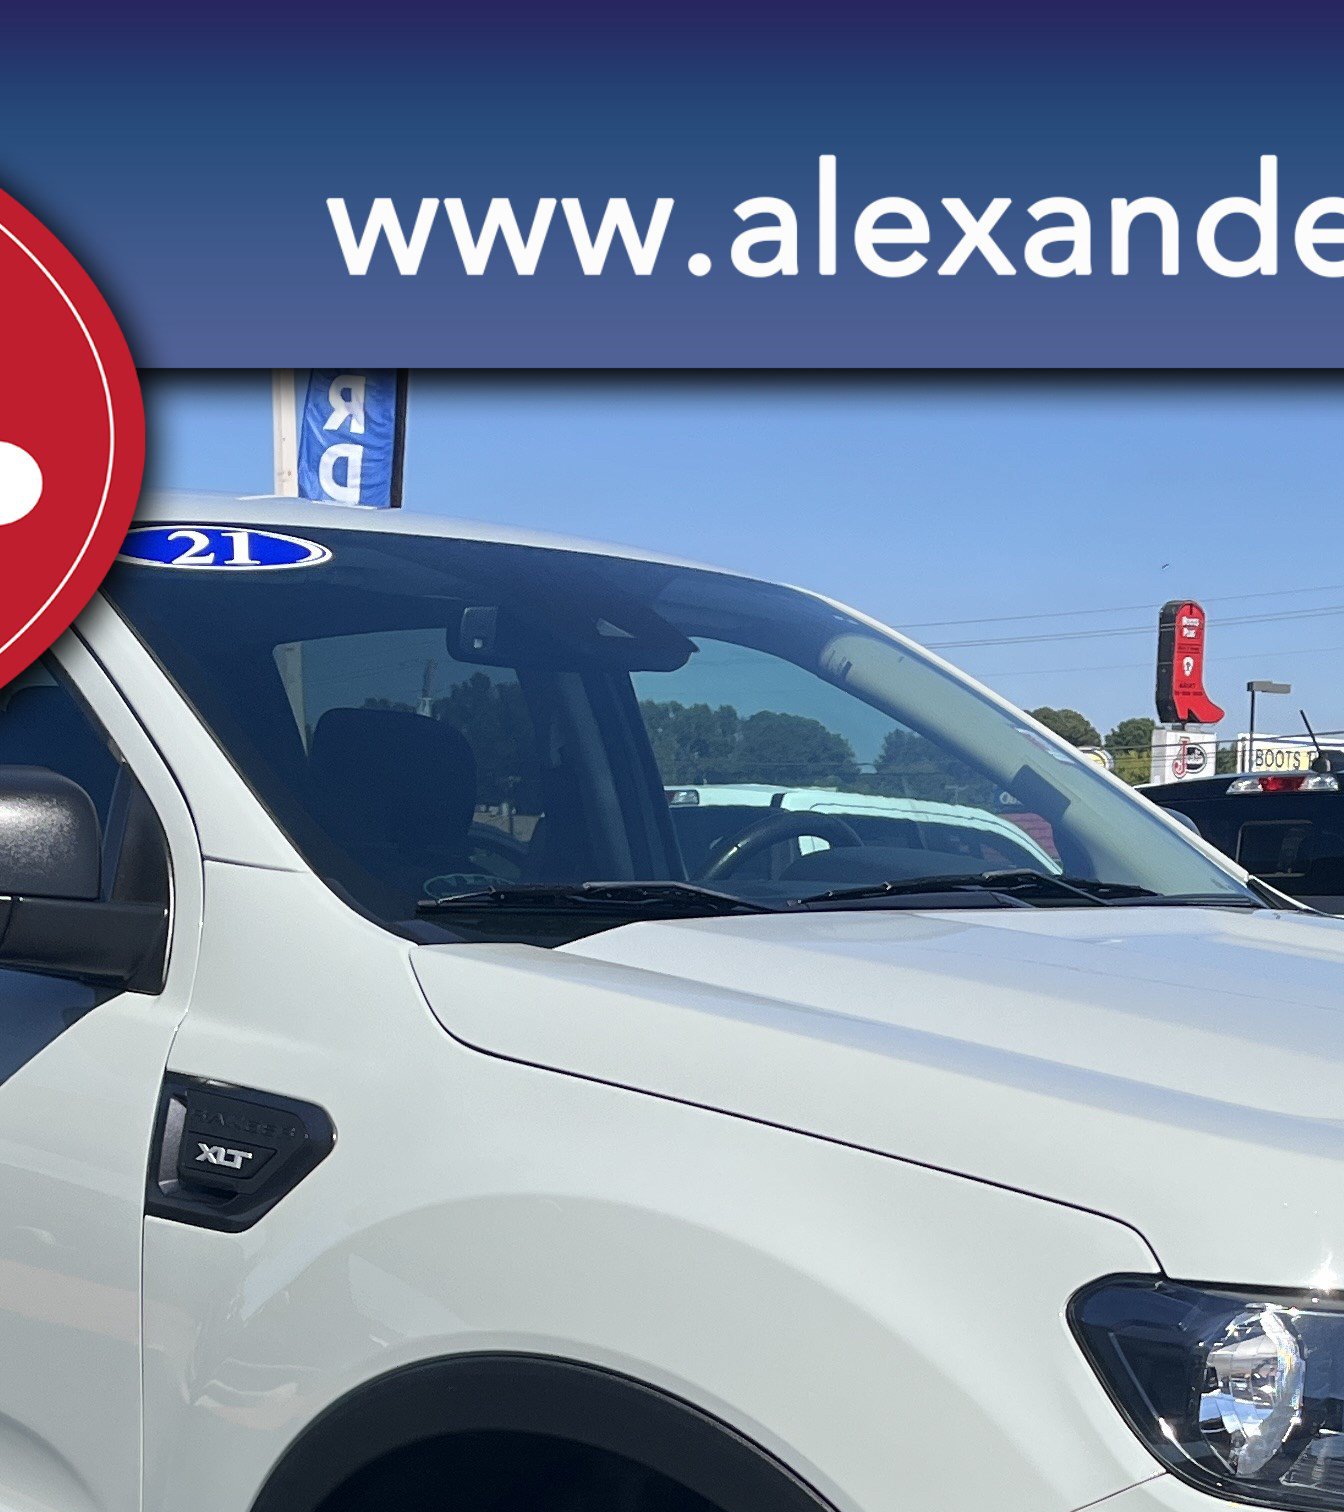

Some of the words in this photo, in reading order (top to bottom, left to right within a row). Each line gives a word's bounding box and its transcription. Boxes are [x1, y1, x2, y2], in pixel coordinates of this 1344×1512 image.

[167, 530, 260, 565] 21
[1255, 748, 1301, 769] BOOTS
[196, 1142, 253, 1169] XLT
